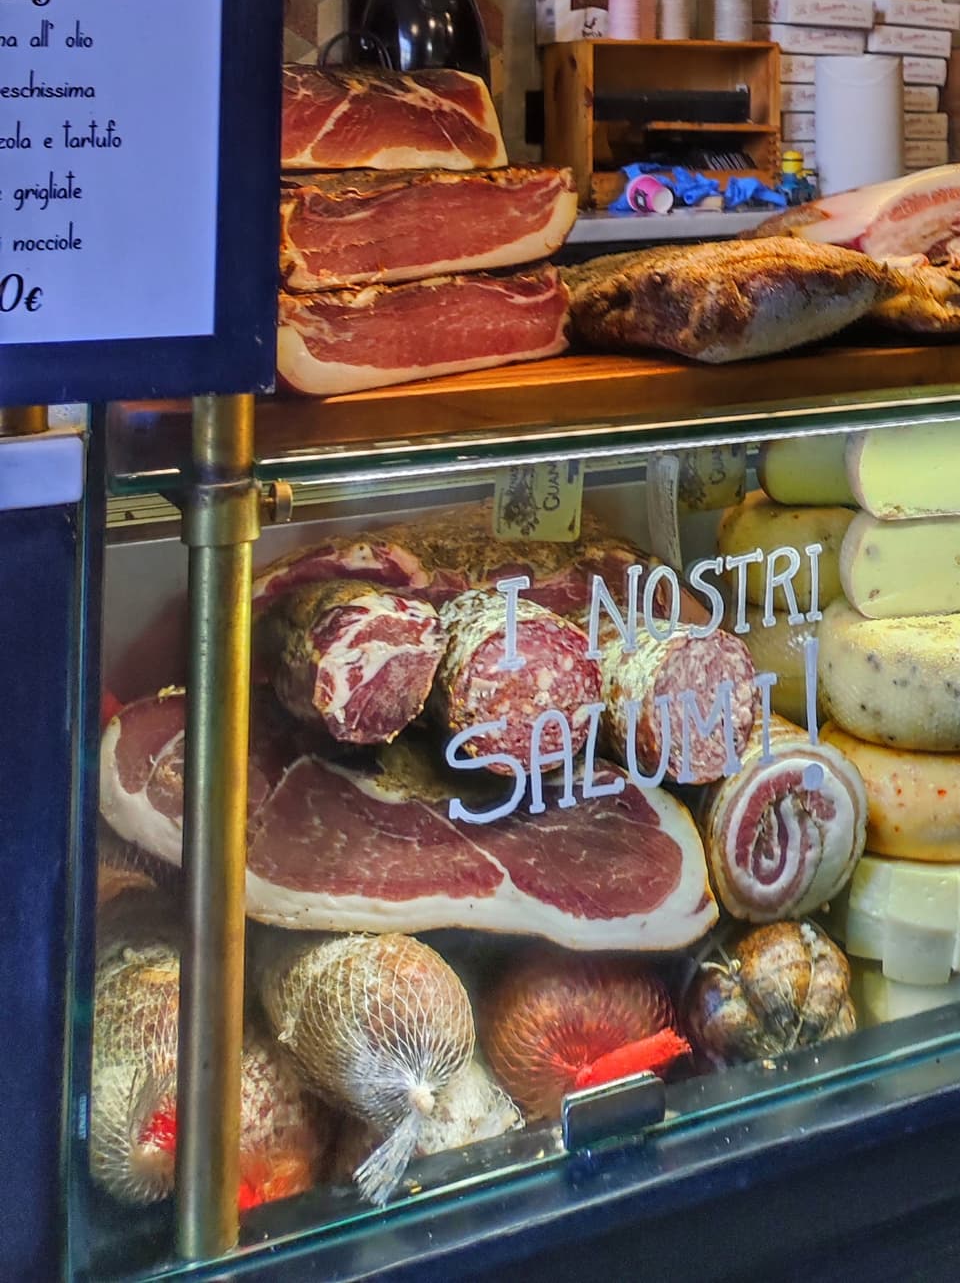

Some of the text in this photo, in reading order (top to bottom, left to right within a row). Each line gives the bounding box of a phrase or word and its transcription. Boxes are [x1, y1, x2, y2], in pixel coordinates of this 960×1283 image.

[65, 20, 94, 48] olio
[0, 69, 95, 98] eschissima
[43, 136, 53, 149] e
[63, 119, 122, 149] tartufo
[13, 170, 83, 211] grigliate
[13, 221, 83, 252] nocciole
[495, 543, 824, 672] I NOSTRI
